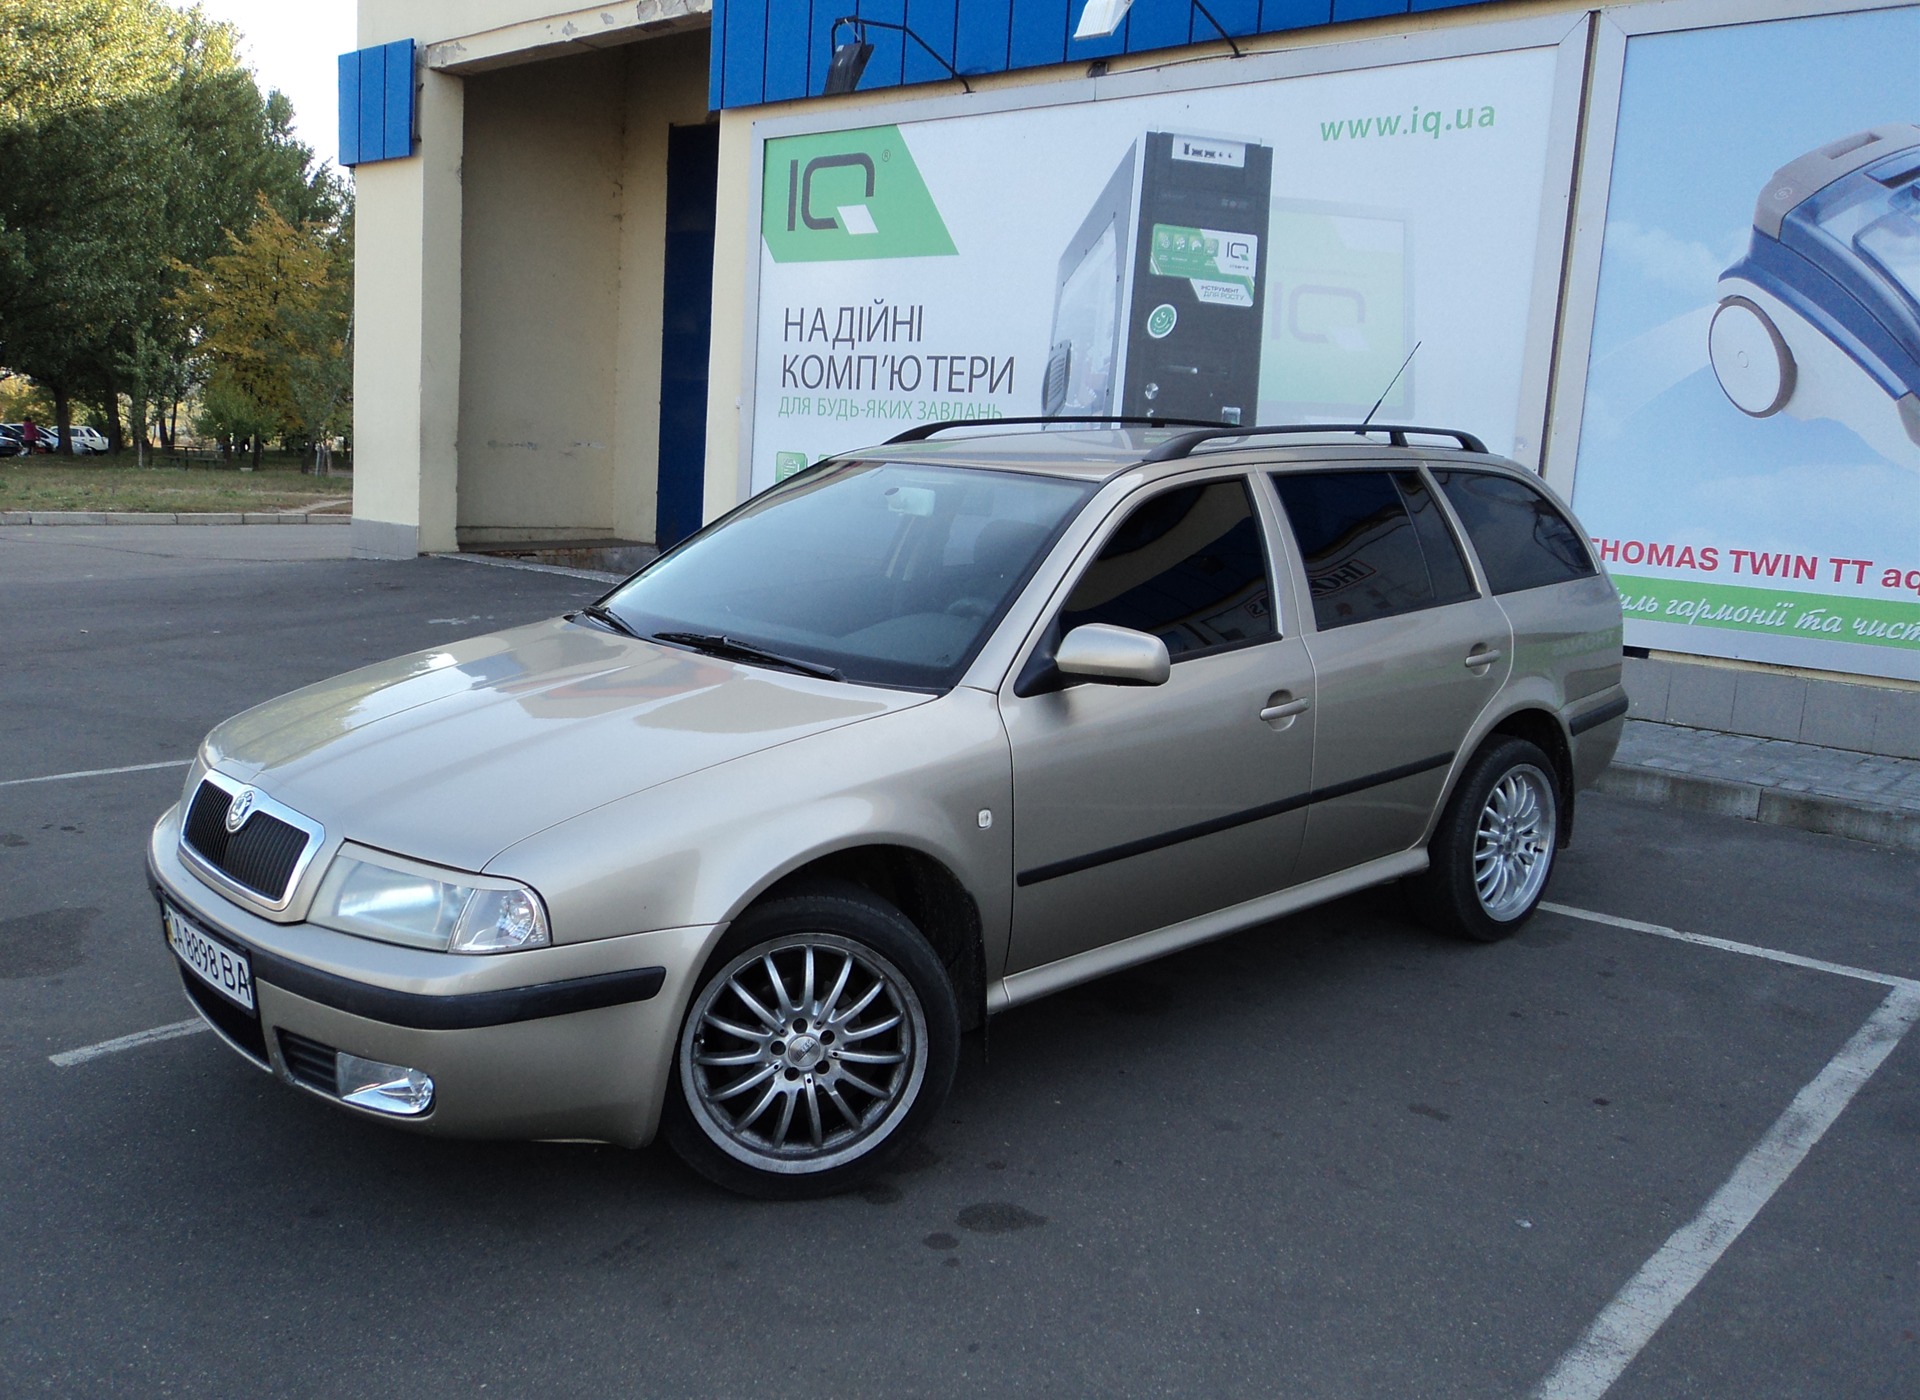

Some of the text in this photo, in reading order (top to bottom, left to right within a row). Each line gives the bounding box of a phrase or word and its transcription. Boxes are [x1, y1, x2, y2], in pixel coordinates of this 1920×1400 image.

[1320, 101, 1495, 141] www.iq.ua
[787, 153, 879, 235] IQ
[1226, 241, 1249, 261] IQ
[783, 298, 924, 350] НАДІЙНІ
[778, 396, 811, 417] ДЛЯ
[817, 398, 913, 421] БУДЬ-ЯКИХ
[1729, 549, 1818, 580] TWIN
[1829, 557, 1873, 585] TT
[1665, 597, 1794, 626] гармонії
[1794, 608, 1842, 633] та
